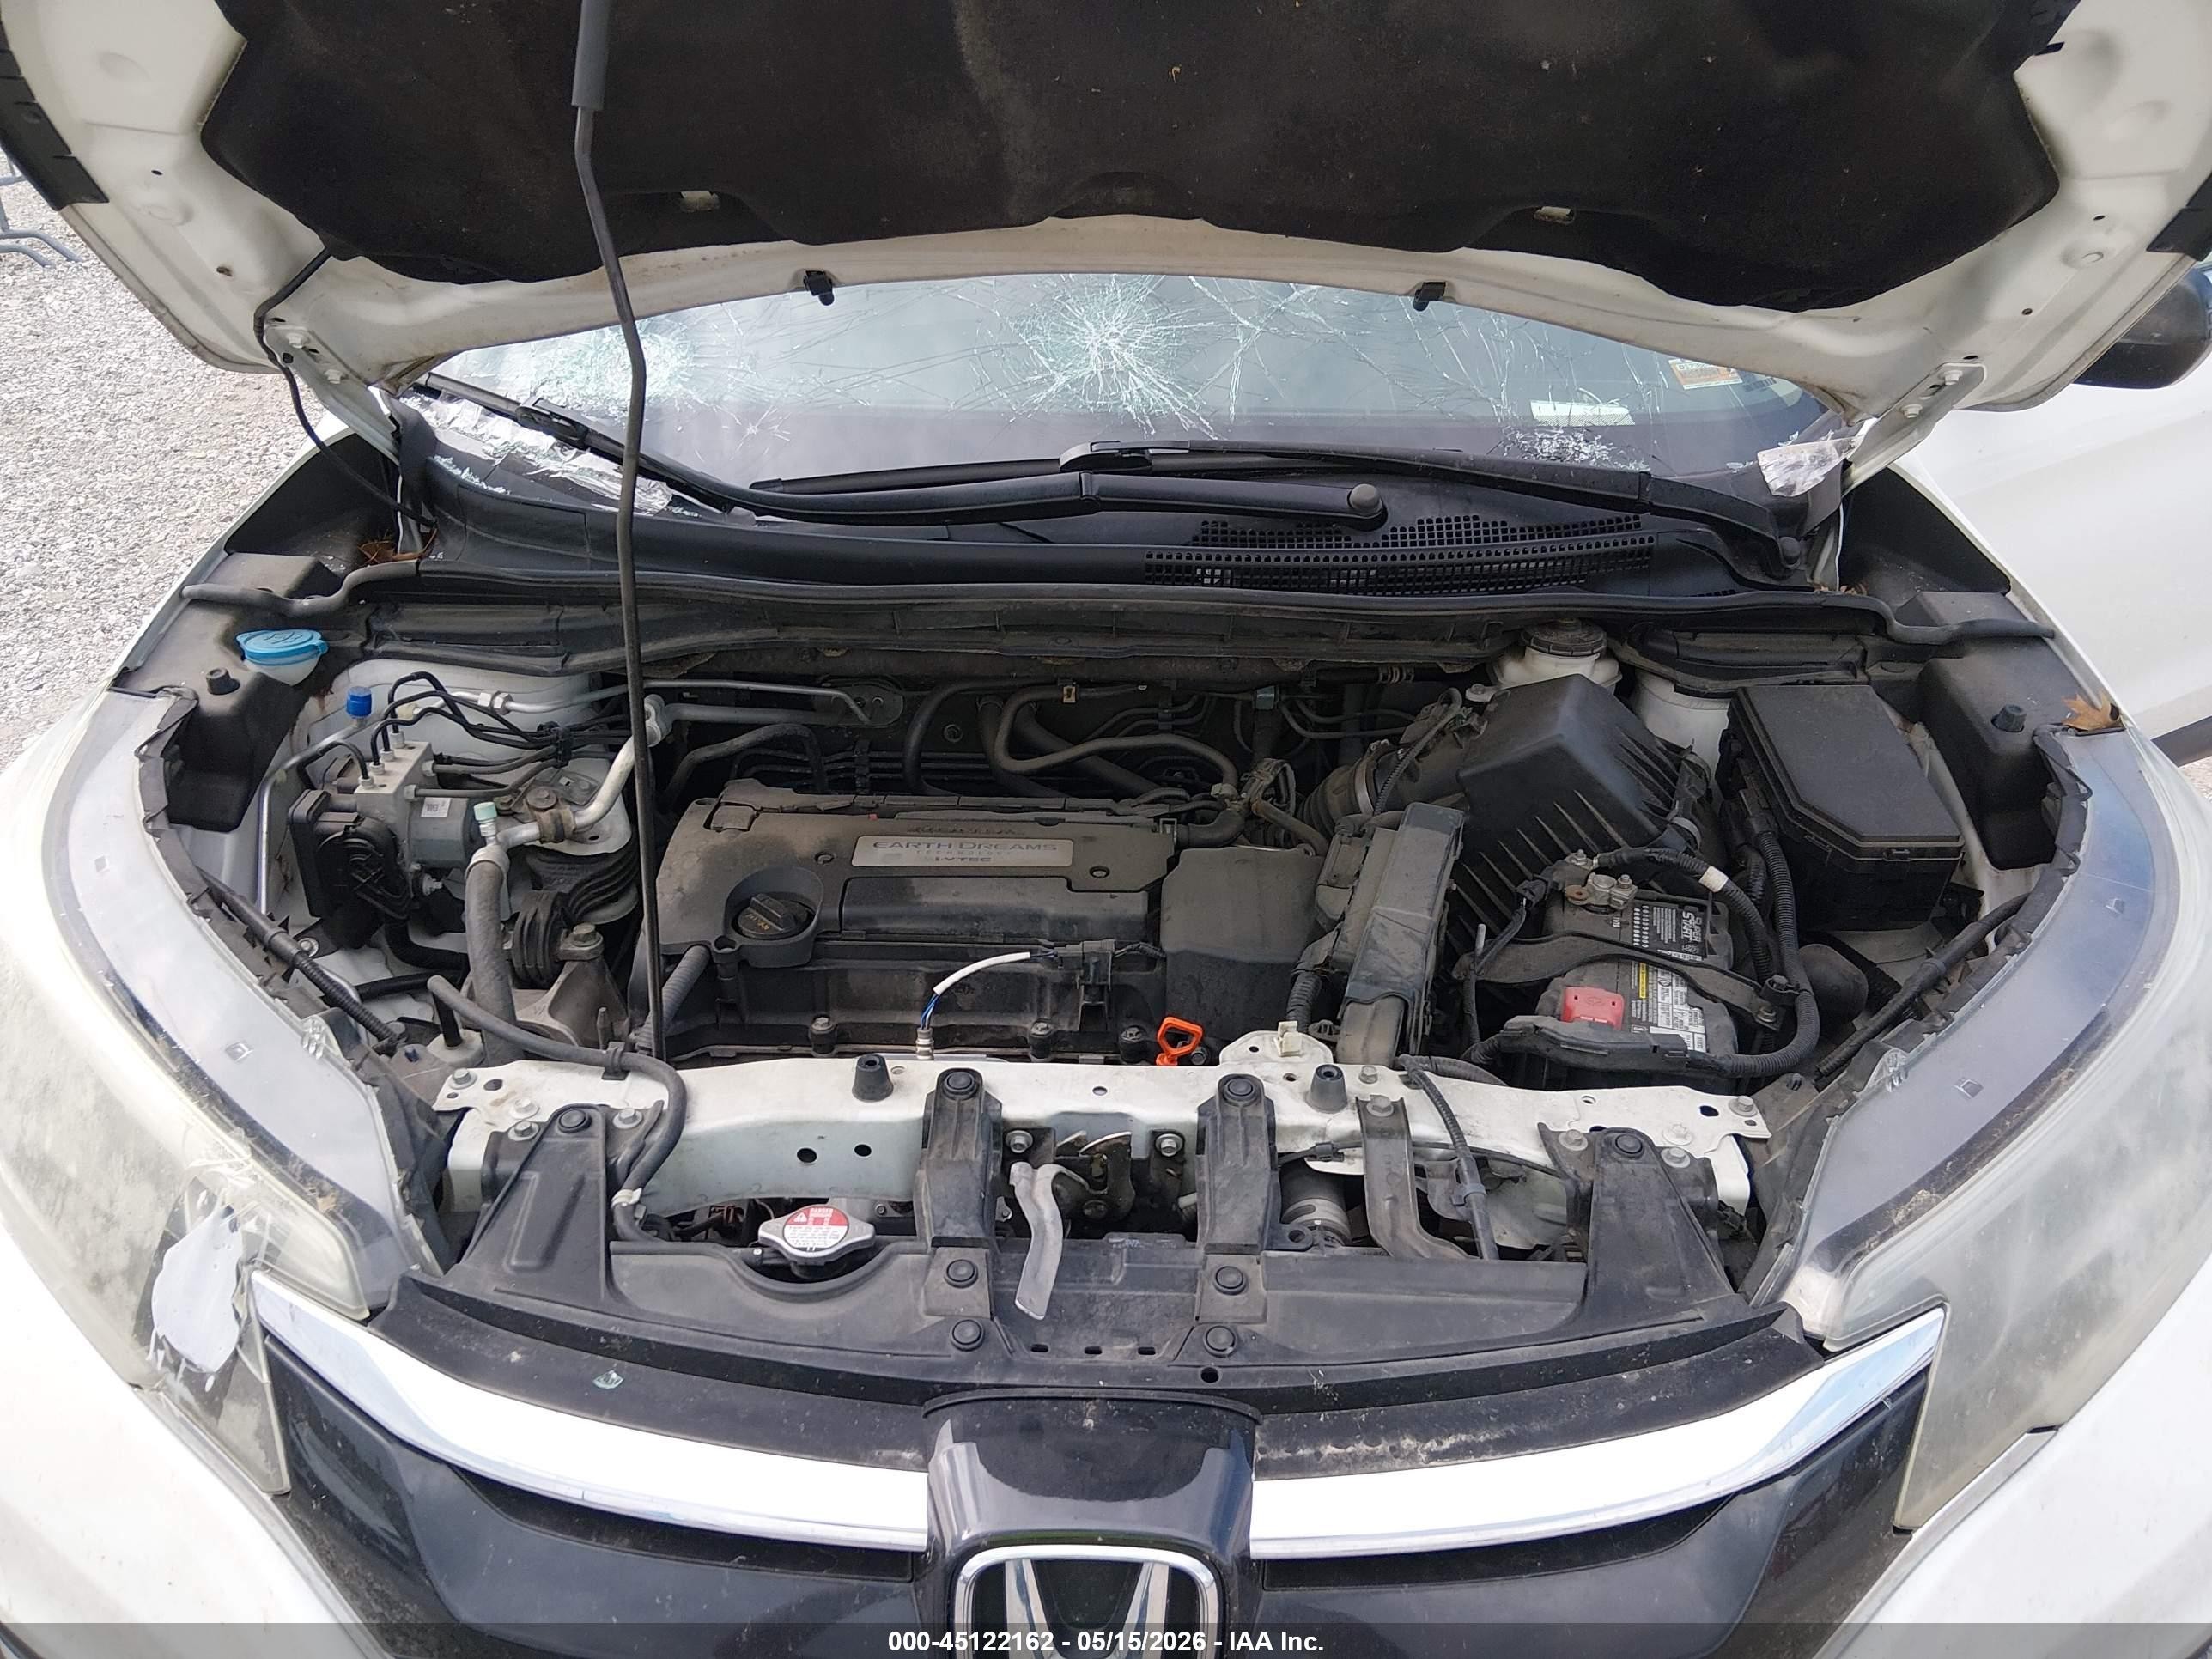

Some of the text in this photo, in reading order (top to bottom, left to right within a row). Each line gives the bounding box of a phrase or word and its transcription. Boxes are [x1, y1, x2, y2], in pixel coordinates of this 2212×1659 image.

[872, 841, 1058, 851] EARTH DREAMS
[1681, 911, 1695, 942] START
[1692, 916, 1703, 943] SUPER
